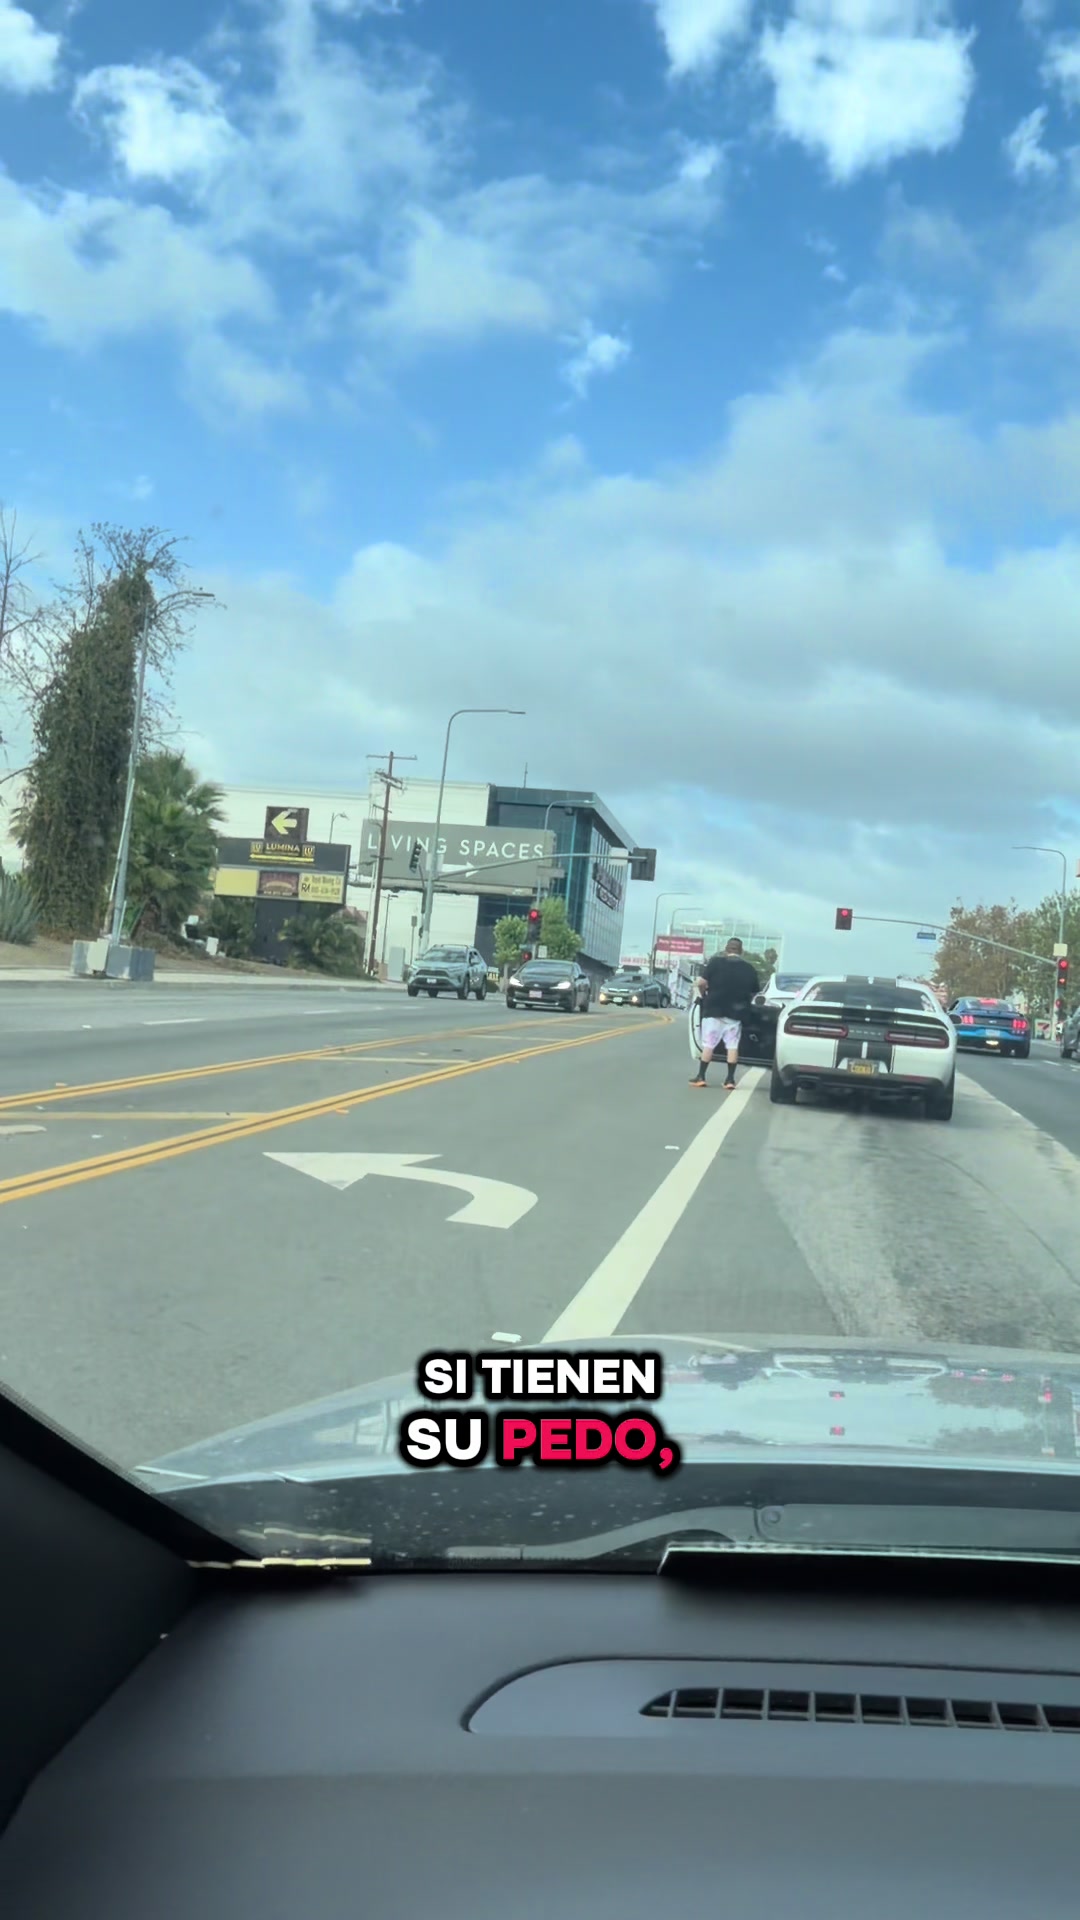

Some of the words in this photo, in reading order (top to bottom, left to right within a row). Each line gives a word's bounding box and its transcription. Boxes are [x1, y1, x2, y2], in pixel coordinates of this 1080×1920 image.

[266, 843, 300, 852] LUMINA
[367, 833, 447, 854] LVING
[459, 839, 544, 860] SPACES
